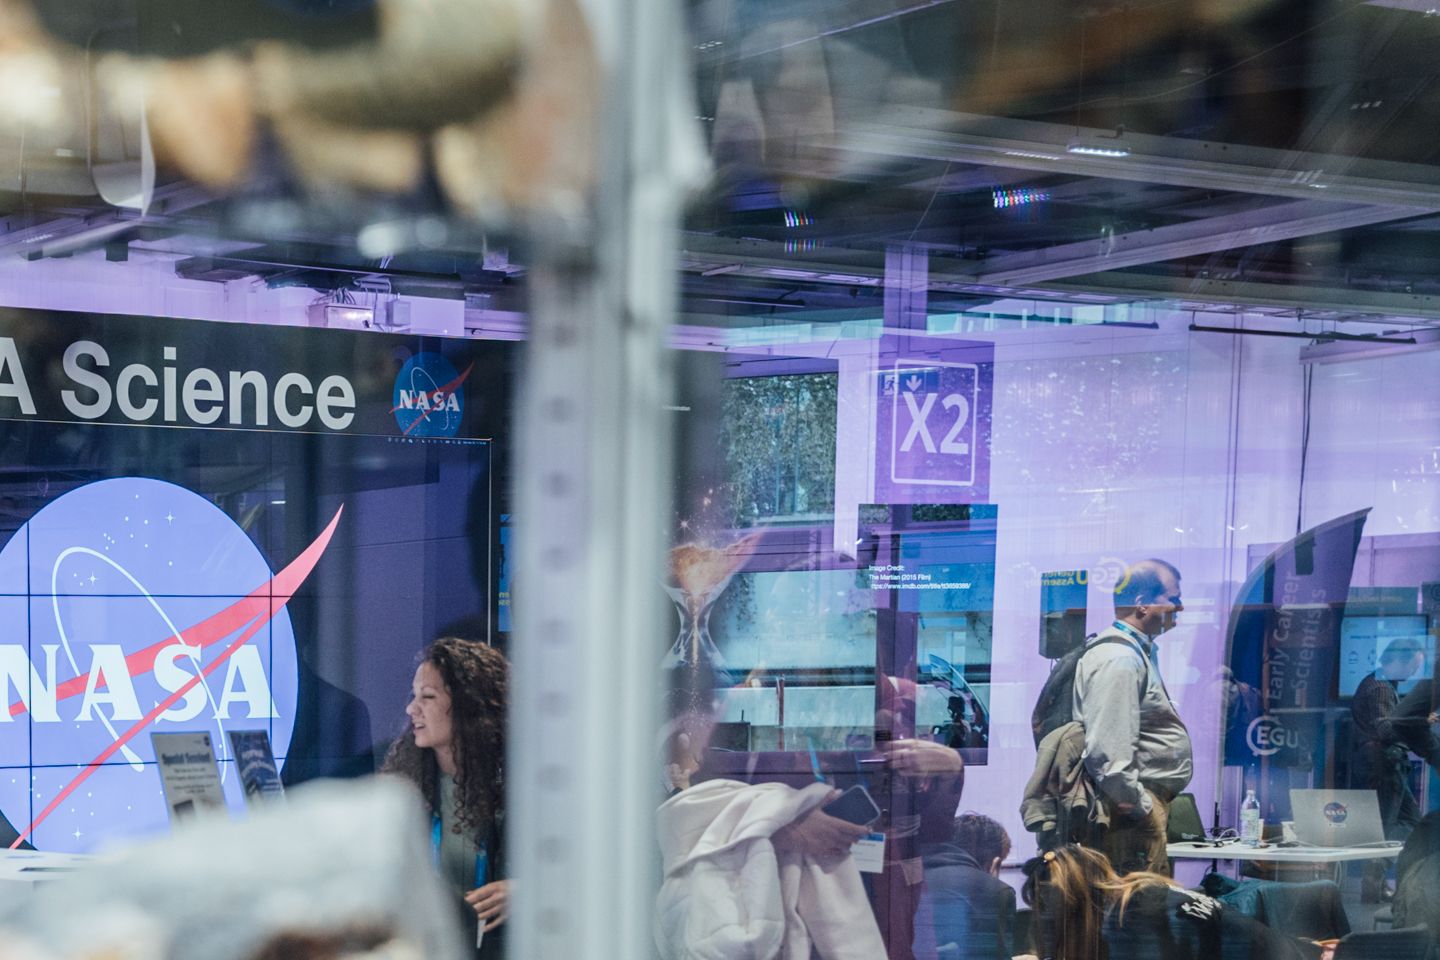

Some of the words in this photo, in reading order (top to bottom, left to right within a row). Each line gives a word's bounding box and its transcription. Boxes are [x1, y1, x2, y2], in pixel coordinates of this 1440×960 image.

[61, 340, 356, 430] Science
[398, 389, 461, 412] NASA
[899, 391, 970, 455] X2
[868, 564, 886, 573] Image
[886, 564, 905, 572] Credit:
[901, 574, 917, 582] (2015
[1266, 647, 1290, 700] Early
[1257, 726, 1299, 748] EGU
